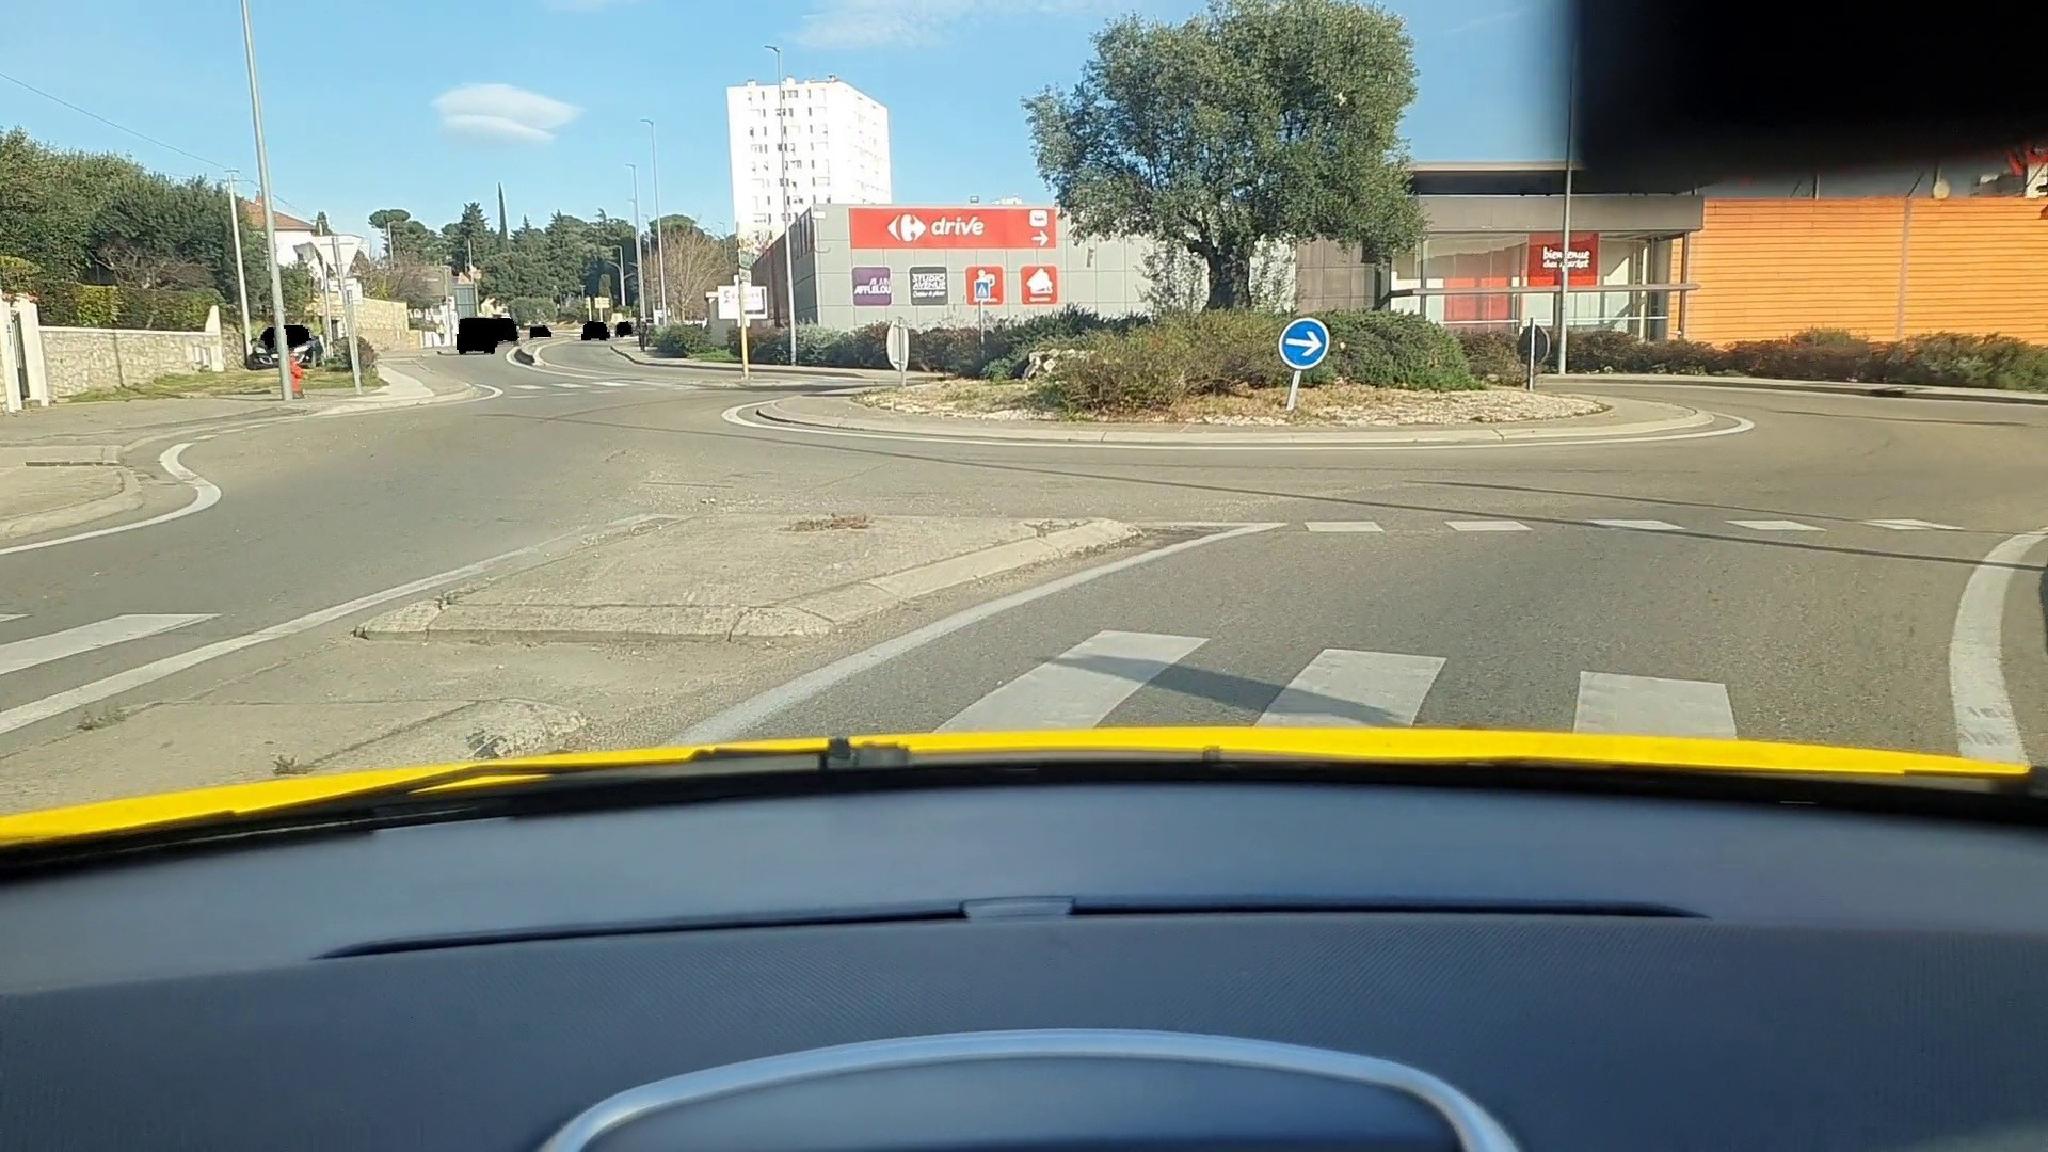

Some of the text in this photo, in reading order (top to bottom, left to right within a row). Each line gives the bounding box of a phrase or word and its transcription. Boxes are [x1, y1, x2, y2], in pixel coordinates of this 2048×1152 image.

[930, 217, 984, 236] drive
[1542, 246, 1590, 260] bienenue
[912, 273, 945, 283] STUDIO
